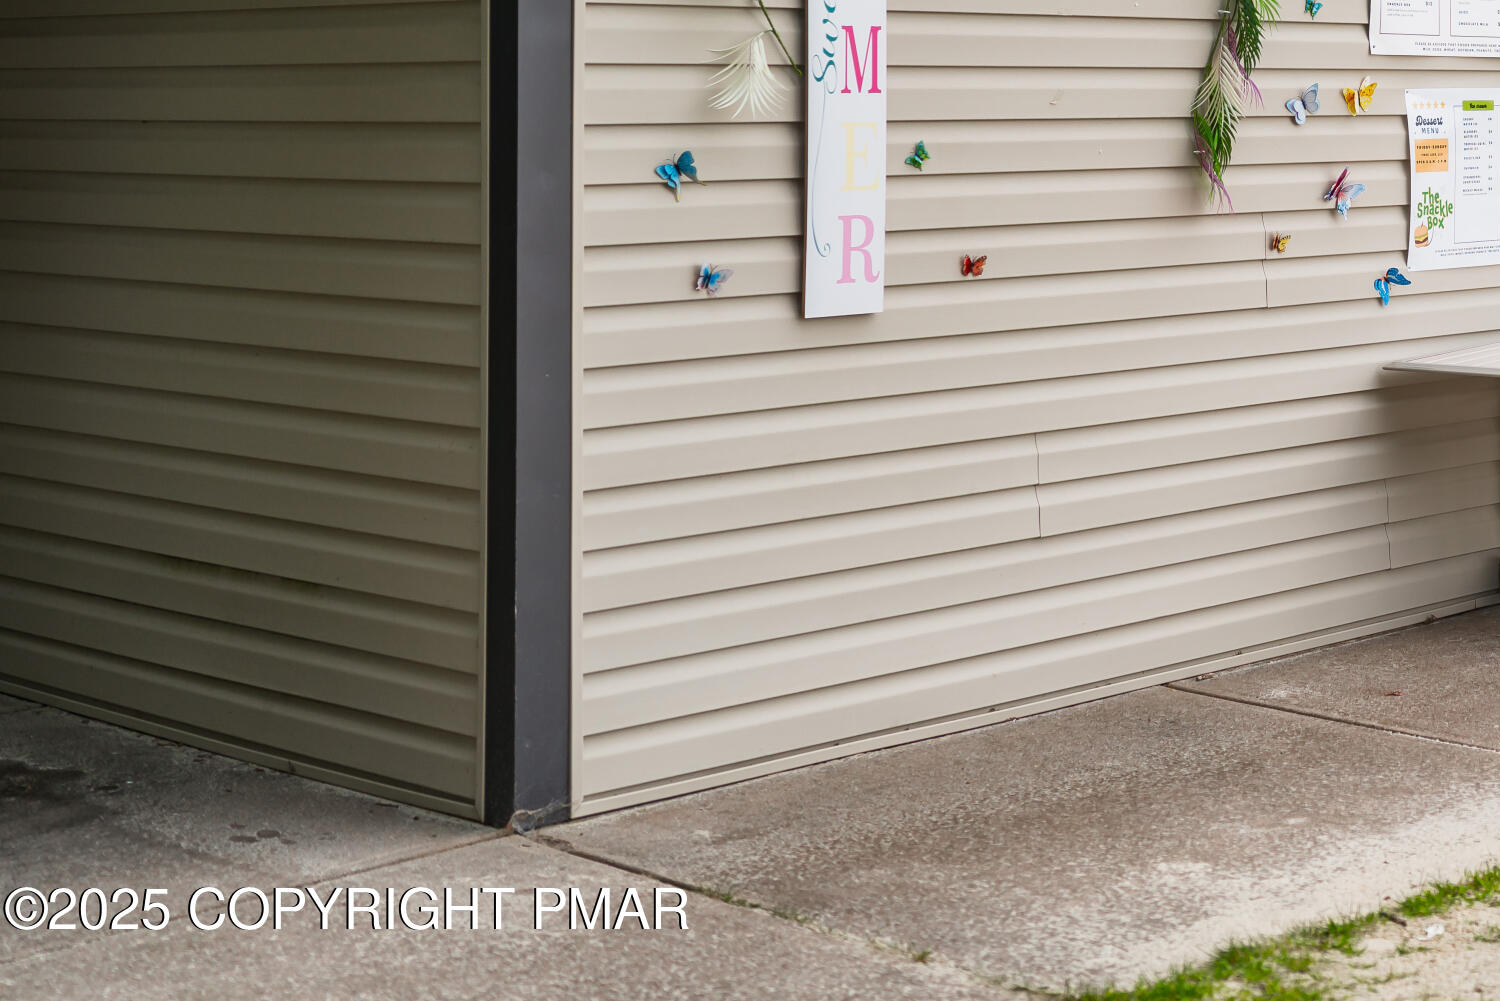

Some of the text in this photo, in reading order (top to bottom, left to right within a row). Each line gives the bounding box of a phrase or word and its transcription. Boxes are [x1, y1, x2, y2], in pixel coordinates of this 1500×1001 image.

[1416, 115, 1443, 126] Dessert
[1422, 186, 1439, 204] The
[1417, 199, 1453, 218] Snackle
[1427, 216, 1444, 230] Box
